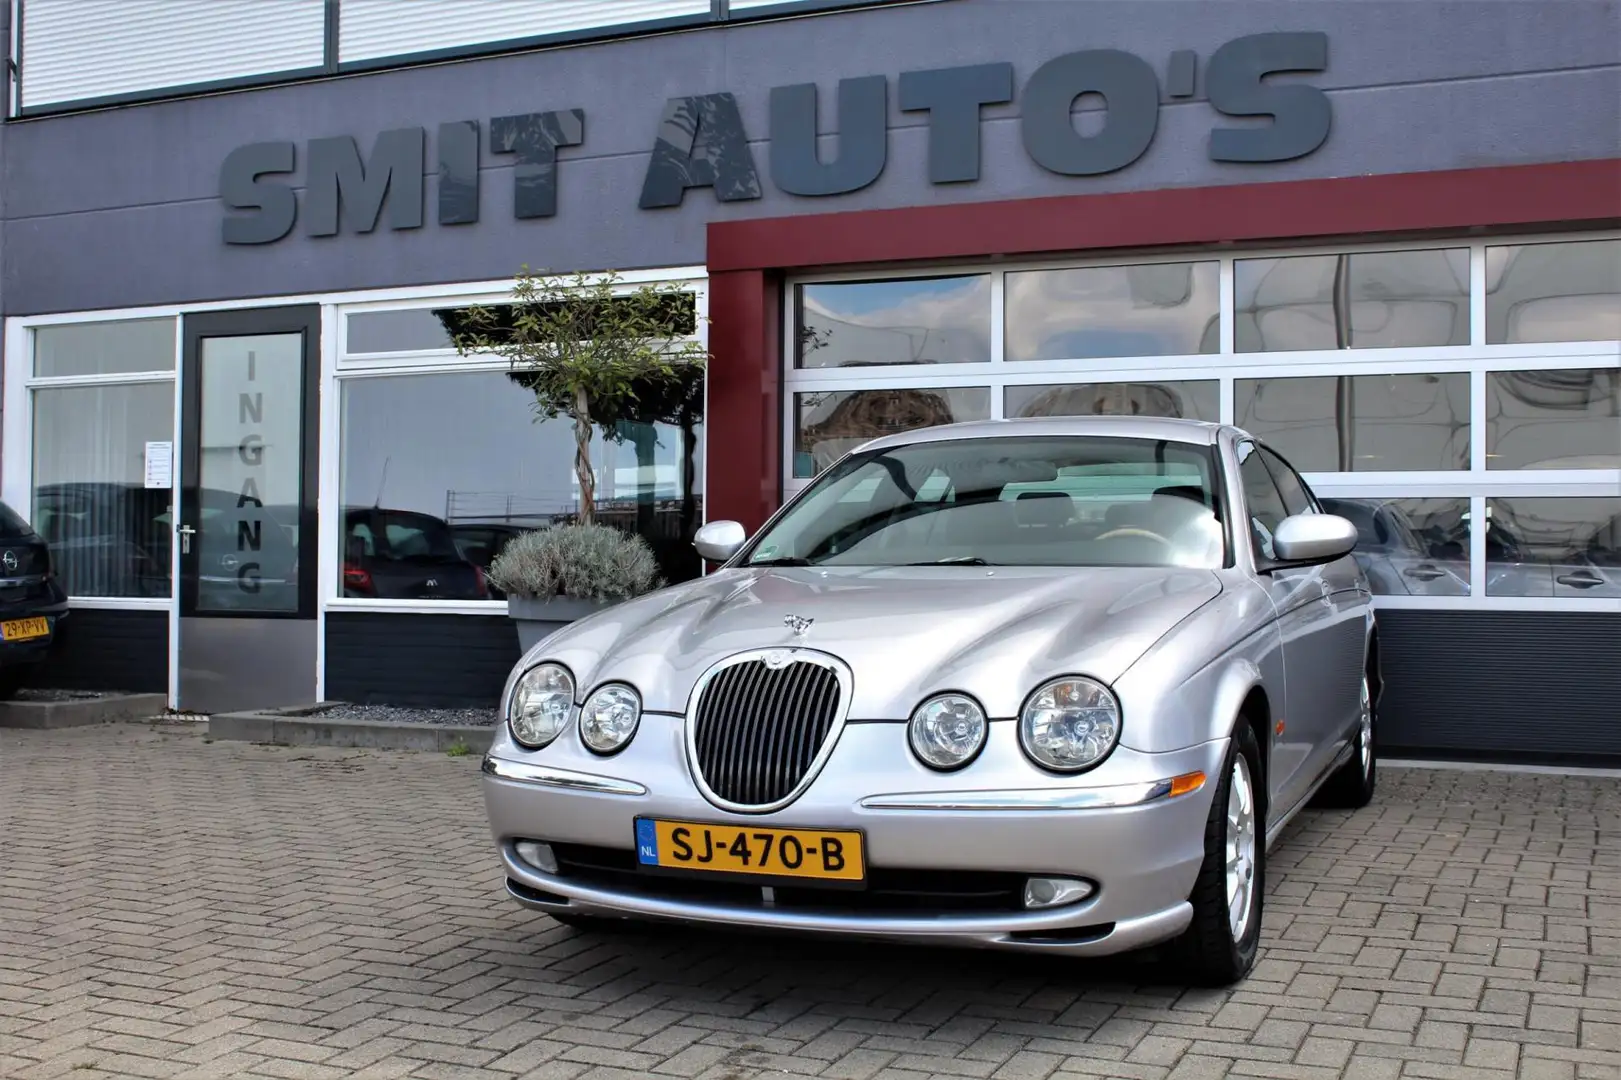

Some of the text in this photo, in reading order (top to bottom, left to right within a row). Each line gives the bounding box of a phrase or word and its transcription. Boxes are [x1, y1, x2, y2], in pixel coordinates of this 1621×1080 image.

[220, 32, 1331, 244] SMIT AUTO'S
[237, 351, 262, 594] INGANG
[641, 828, 845, 871] NL SJ-470-B
